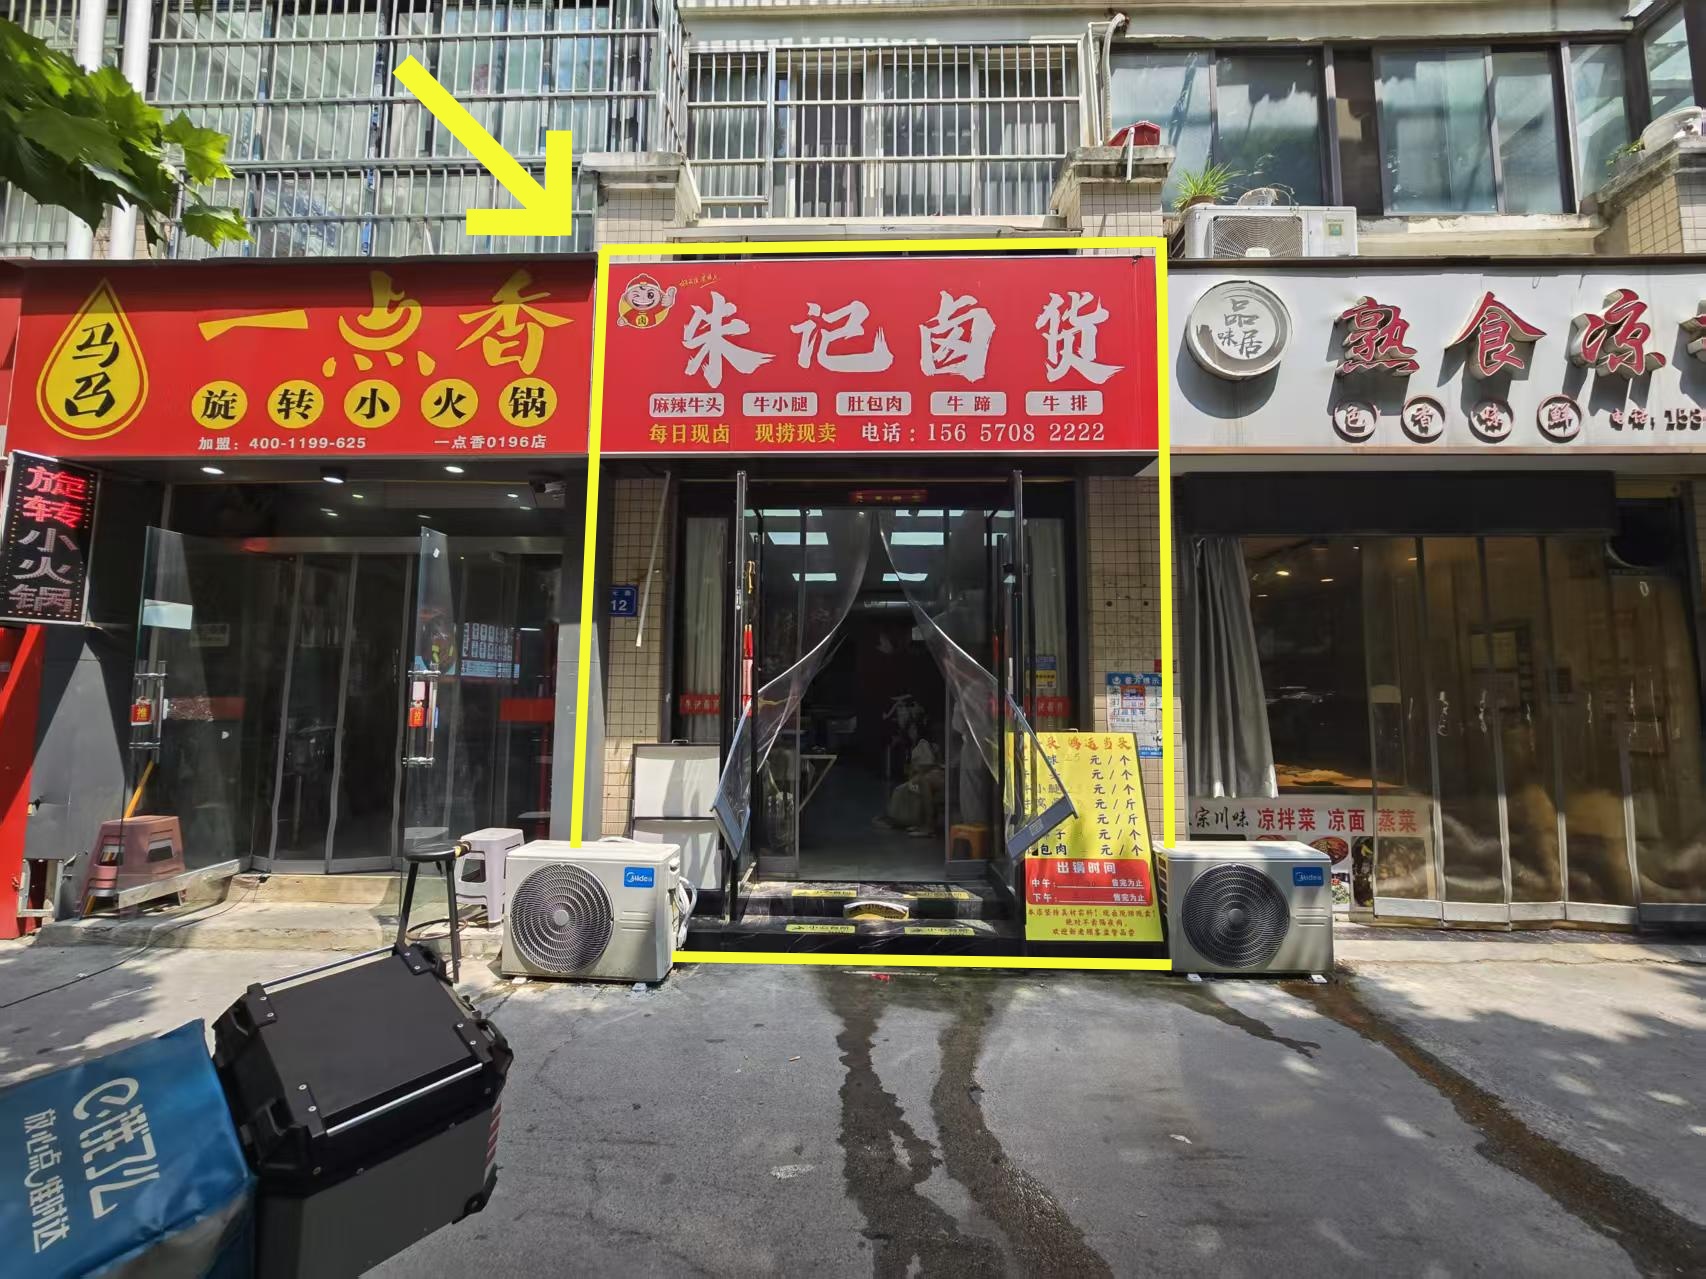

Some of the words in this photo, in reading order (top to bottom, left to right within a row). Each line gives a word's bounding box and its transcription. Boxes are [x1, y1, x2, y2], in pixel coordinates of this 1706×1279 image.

[199, 269, 574, 378] 一点香
[1334, 288, 1706, 378] 熟食凉
[681, 290, 1126, 389] 朱记卤货
[200, 386, 547, 420] 旋转小火锅
[652, 395, 723, 413] 麻辣牛头
[753, 395, 808, 413] 牛小腿
[847, 395, 903, 413] 肚包肉
[947, 395, 992, 413] 牛蹄
[1042, 395, 1089, 413] 牛排
[1344, 402, 1574, 433] 色香味鲜
[434, 434, 547, 449] 一点香0196店
[649, 422, 730, 443] 每日现卤
[755, 422, 837, 443] 现捞现卖
[980, 422, 1035, 442] 5708
[1049, 422, 1105, 442] 2222
[9, 465, 87, 613] 旋转小火锅
[610, 599, 627, 611] 12
[1188, 805, 1249, 831] 宗川味
[1257, 807, 1316, 832] 凉拌菜
[1327, 808, 1366, 832] 凉面
[1378, 808, 1417, 832] 蒸菜
[1056, 861, 1117, 875] 出锅时间
